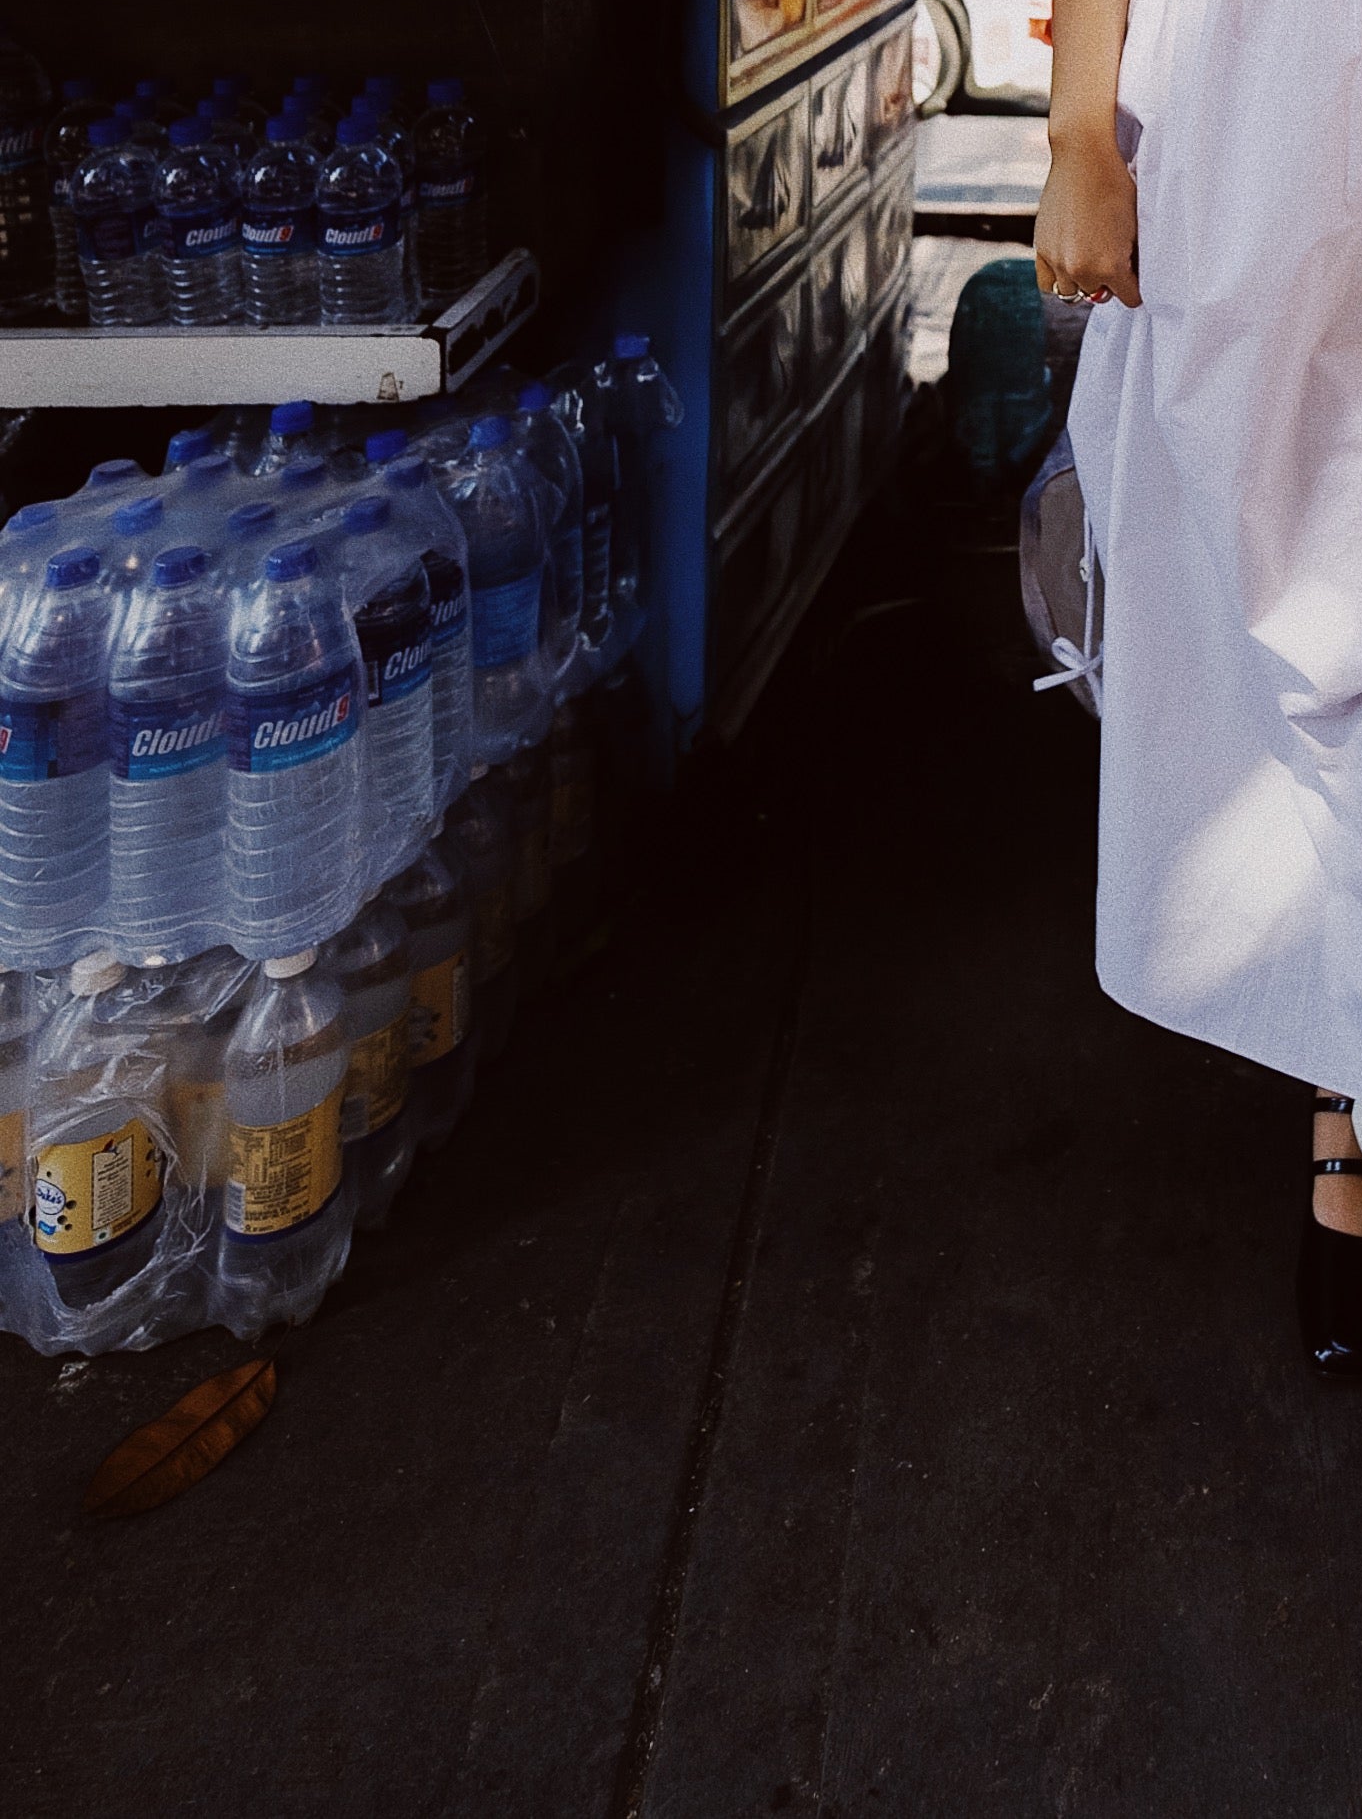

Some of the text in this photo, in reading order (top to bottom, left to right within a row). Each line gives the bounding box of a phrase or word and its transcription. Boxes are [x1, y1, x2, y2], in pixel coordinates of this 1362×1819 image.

[324, 227, 373, 245] Cloud
[131, 713, 217, 758] Cloud
[253, 701, 337, 750] Cloud
